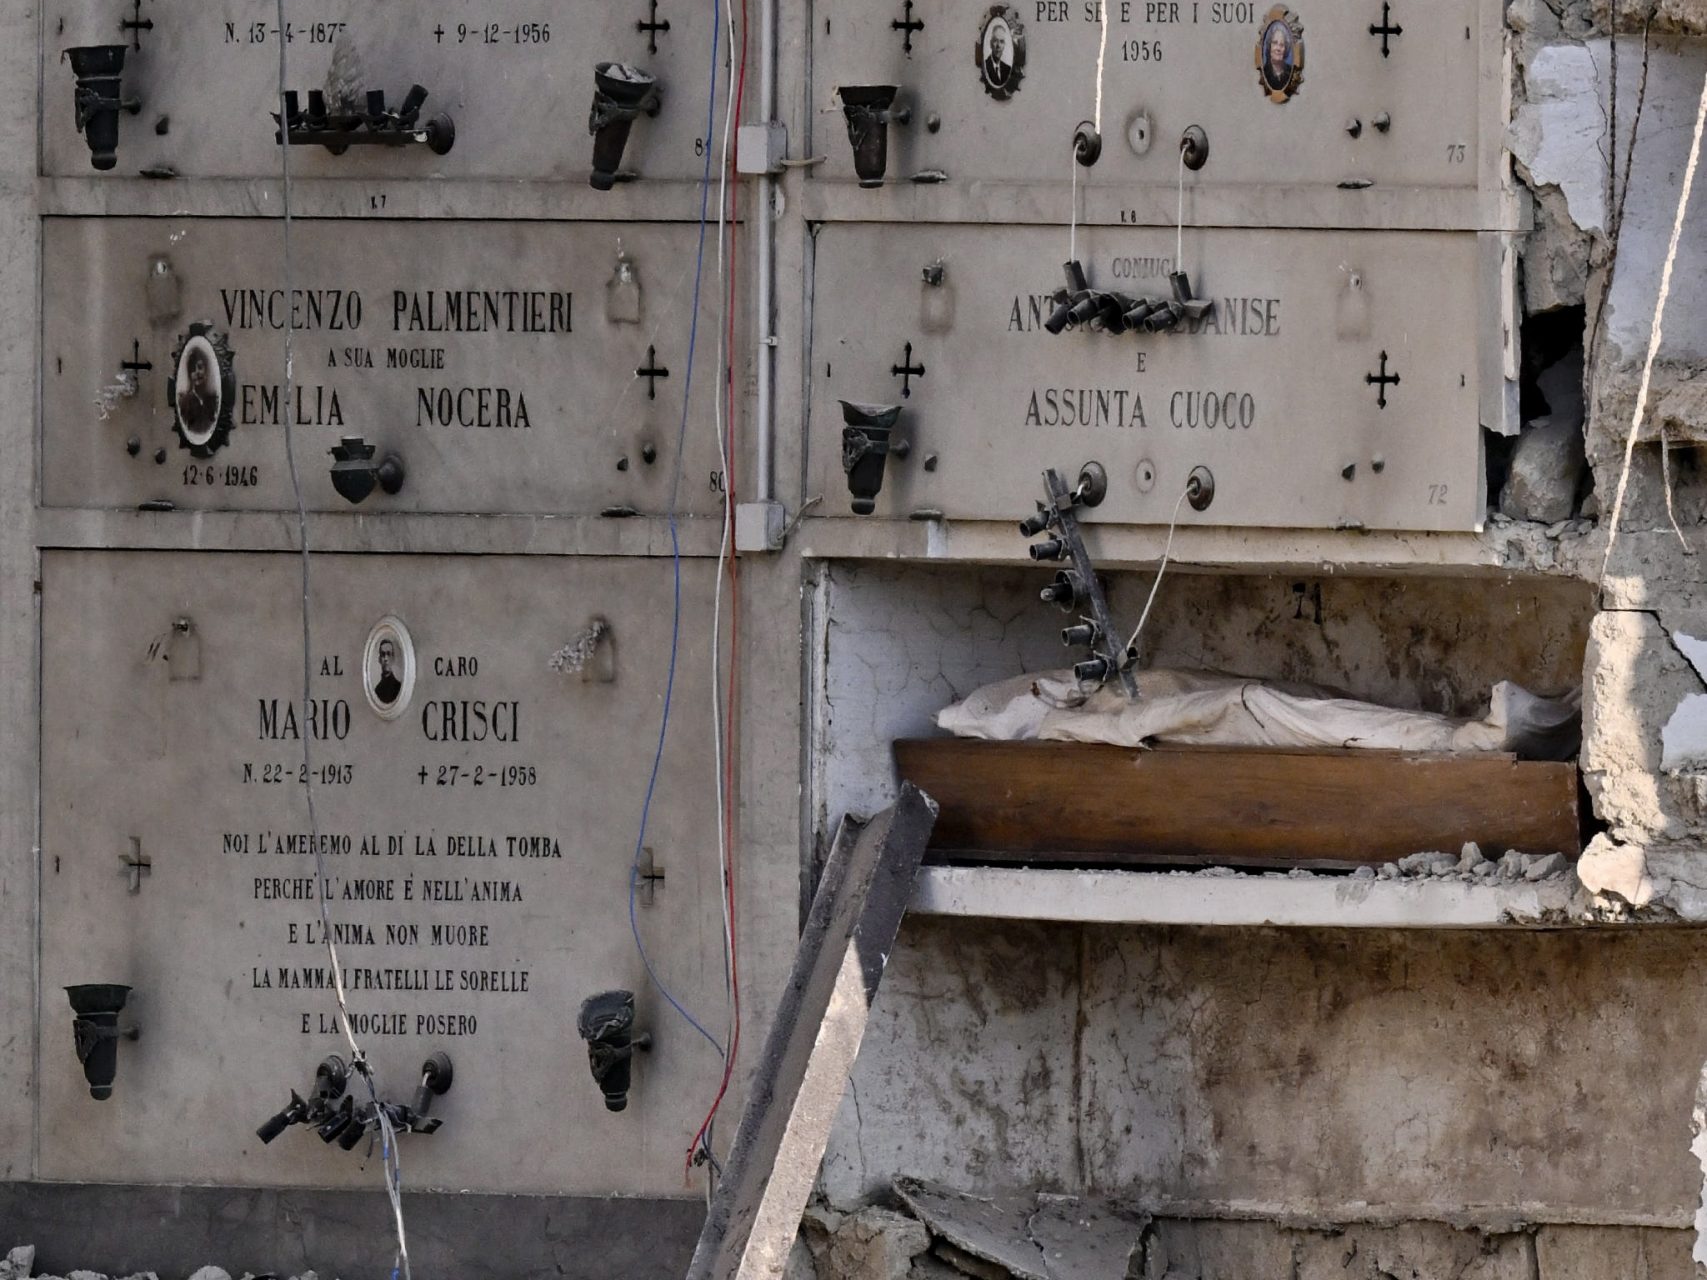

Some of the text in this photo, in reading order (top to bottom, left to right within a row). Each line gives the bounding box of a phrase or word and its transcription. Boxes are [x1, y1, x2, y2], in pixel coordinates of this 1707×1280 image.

[1035, 1, 1069, 21] PER
[1121, 1, 1130, 22] E
[1146, 2, 1180, 23] PER
[1193, 3, 1198, 23] I
[1212, 3, 1255, 23] SUOI
[225, 22, 240, 43] N.
[249, 22, 346, 43] 13-4-187
[457, 23, 550, 43] 9-12-1956
[1122, 40, 1162, 61] 1956
[220, 289, 572, 333] VINCENZO PALMENTIERI
[328, 347, 445, 369] A SUA MOGLIE
[1137, 352, 1145, 372] E
[241, 385, 531, 428] EMLIA NOCERA
[1025, 388, 1255, 429] ASSUNTA CUOCO
[1428, 484, 1448, 505] 72
[320, 656, 479, 677] AL CARO
[258, 699, 520, 743] MARIO CRISCI
[242, 763, 258, 784] N.
[436, 765, 537, 786] 27-2-1958
[222, 833, 249, 854] NOI
[360, 835, 381, 856] AL
[447, 835, 498, 858] DELLA
[506, 836, 562, 858] TOMBA
[325, 876, 395, 901] L'AMORE
[423, 877, 523, 903] NELL'ANIMA
[288, 923, 298, 944] E
[386, 924, 420, 946] NON
[431, 925, 490, 947] MUORE
[252, 967, 530, 992] LA MAMMA I FRATELLI LE SORELLE
[302, 1013, 478, 1036] E LA MOGLIE POSERO
